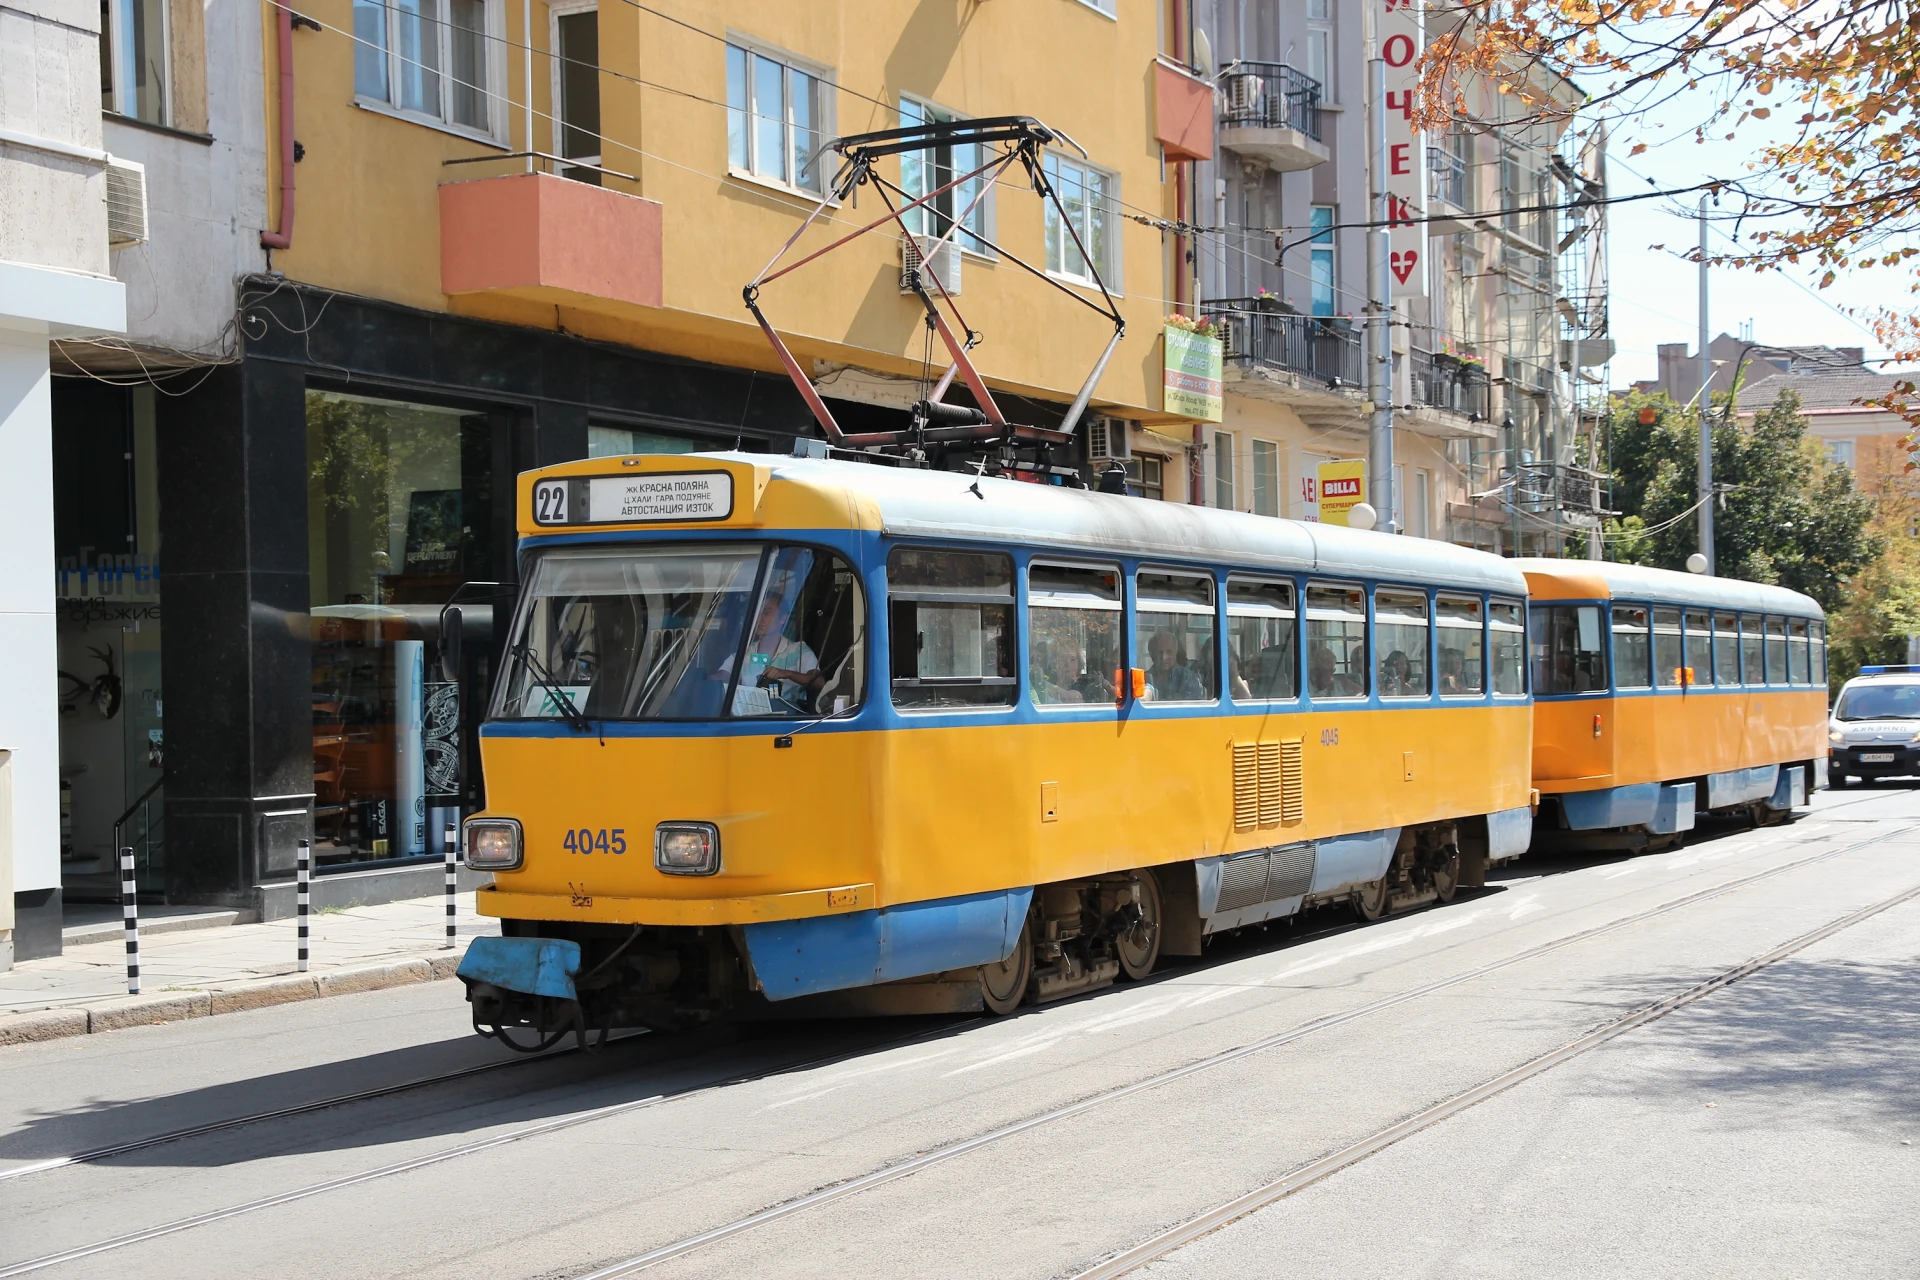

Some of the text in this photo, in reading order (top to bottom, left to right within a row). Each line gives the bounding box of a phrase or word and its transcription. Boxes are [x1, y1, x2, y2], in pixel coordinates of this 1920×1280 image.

[639, 482, 673, 493] КРАСНА
[674, 480, 709, 491] ПОЛЯНА
[1324, 481, 1358, 495] BILLA
[538, 486, 565, 521] 22
[655, 494, 675, 503] ГАРА
[676, 492, 712, 502] ПОДУЯНЕ
[621, 502, 714, 516] АВТОСТАНЦИЯ ИЗТОК
[407, 550, 457, 562] DEPLOYMENT
[1320, 728, 1339, 747] 4045
[377, 799, 387, 835] SAGA
[563, 828, 627, 855] 4045
